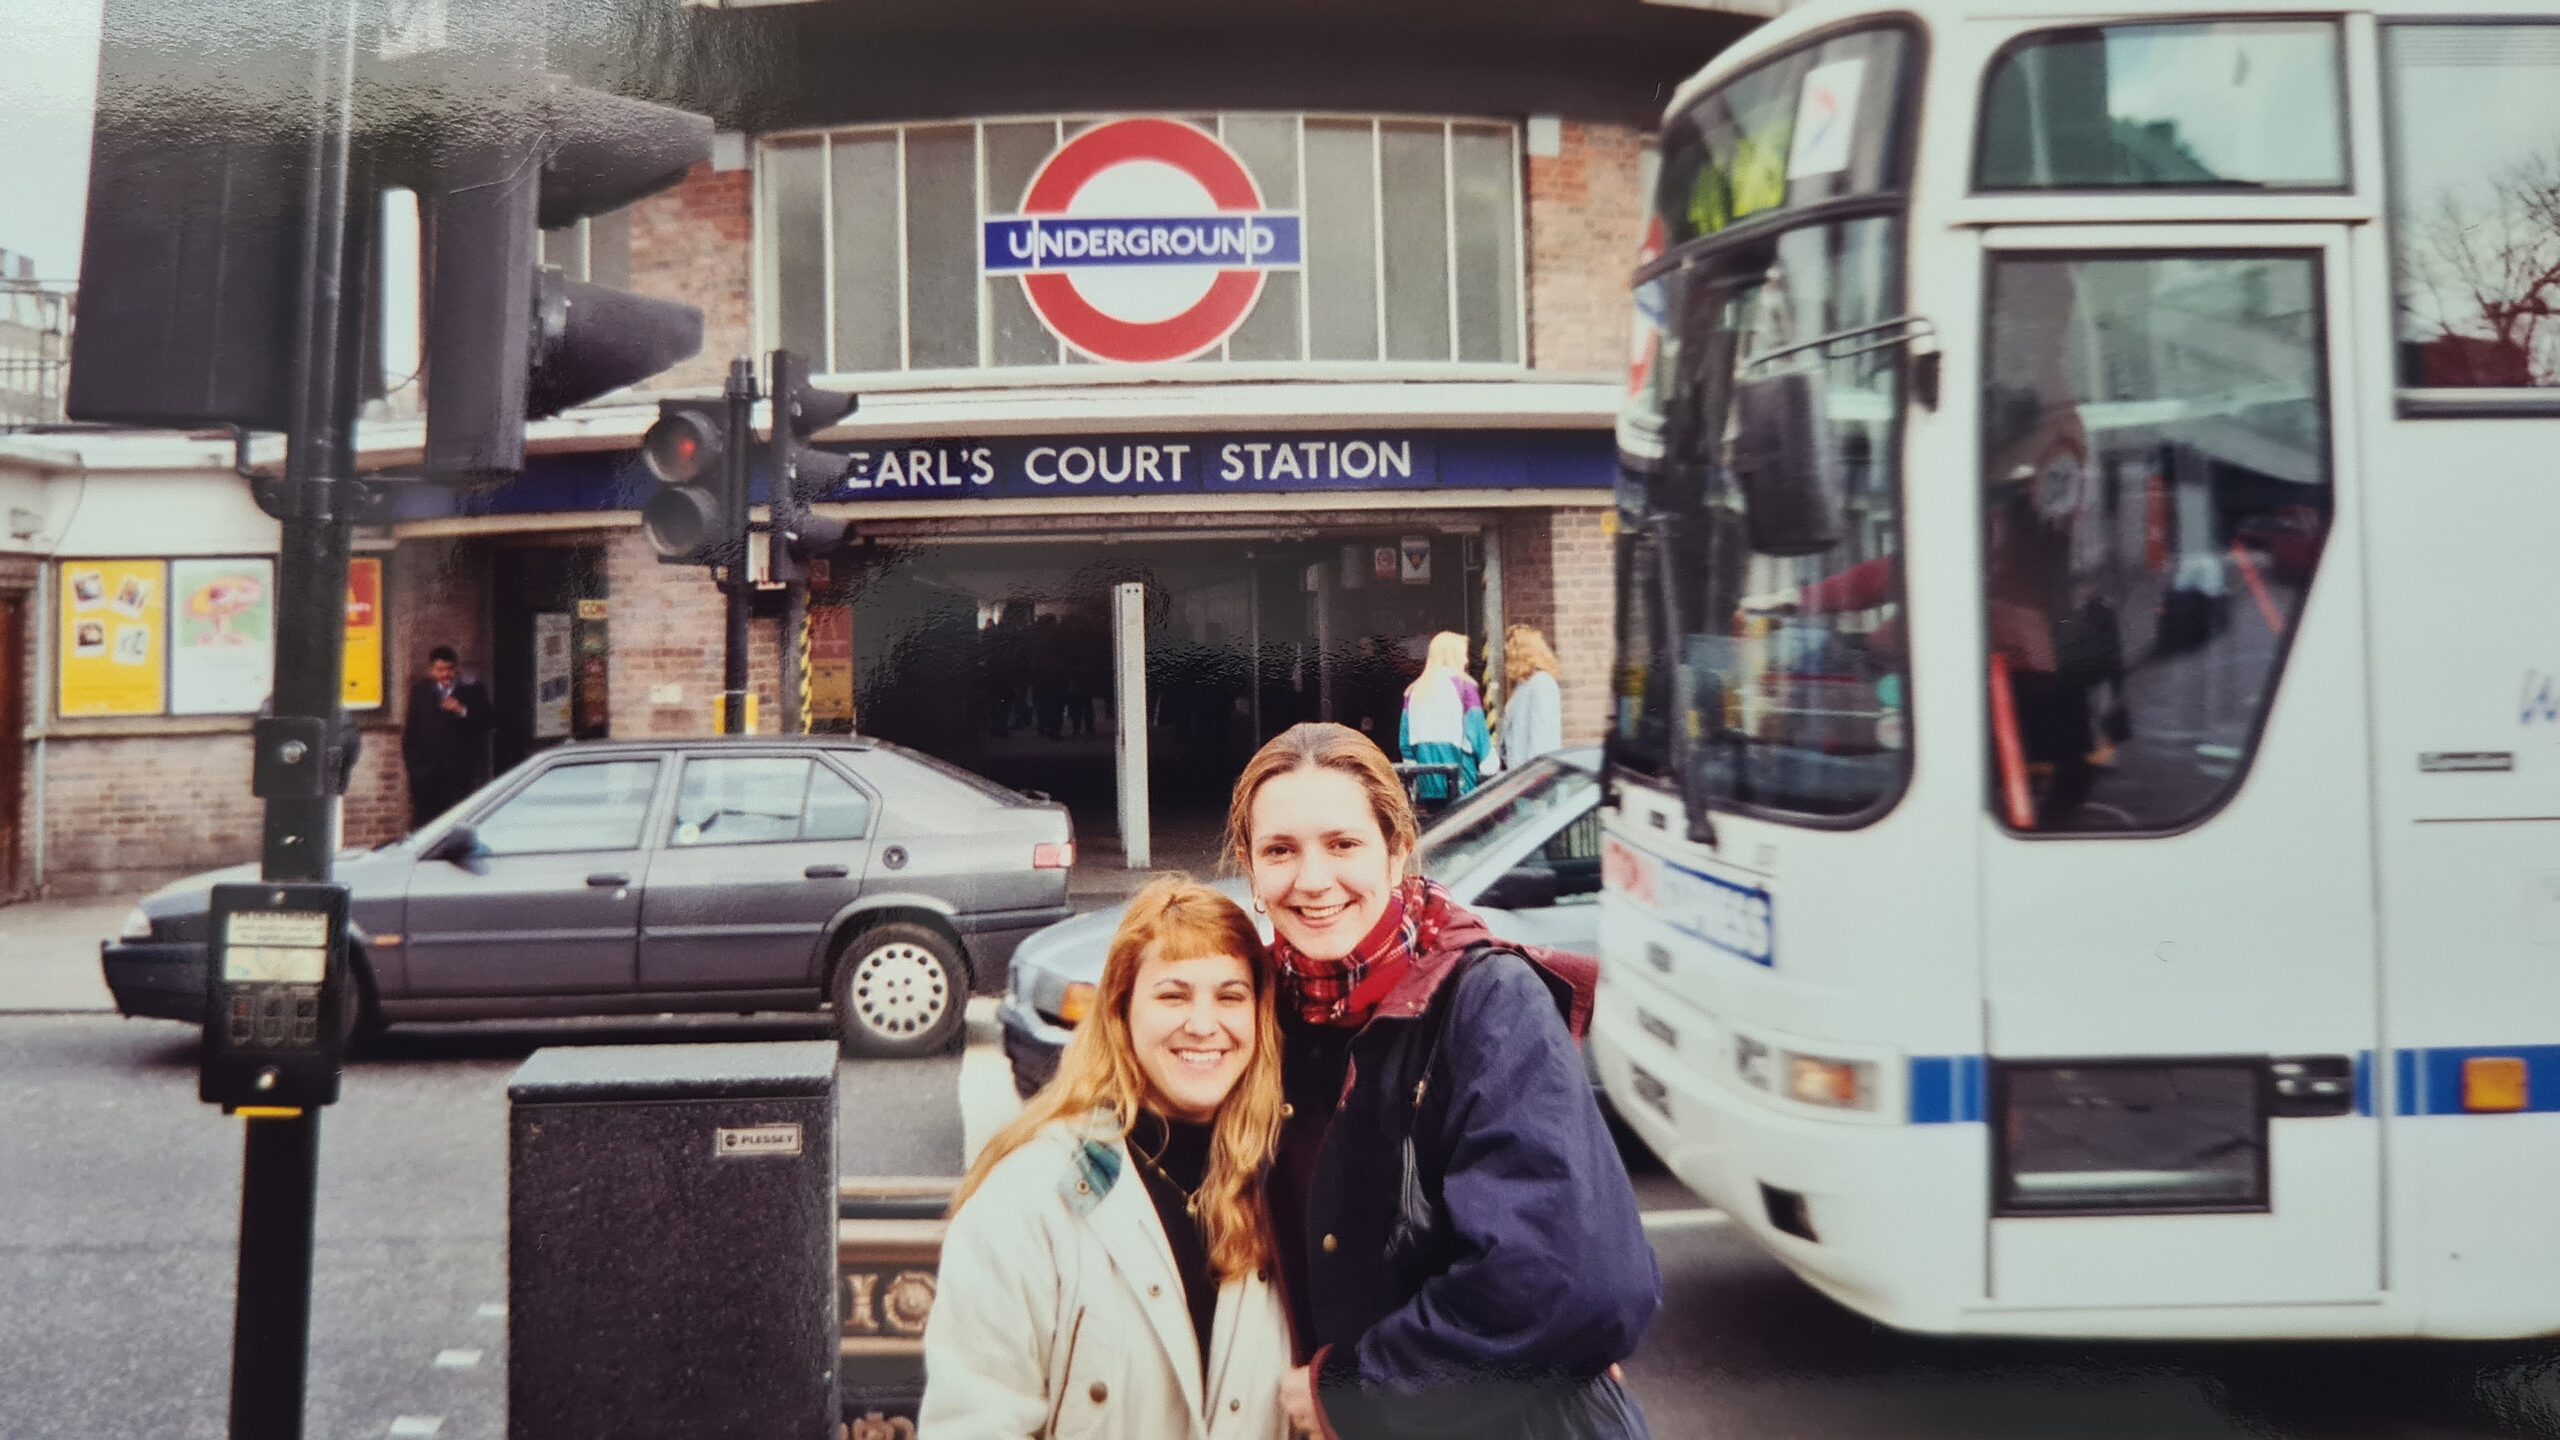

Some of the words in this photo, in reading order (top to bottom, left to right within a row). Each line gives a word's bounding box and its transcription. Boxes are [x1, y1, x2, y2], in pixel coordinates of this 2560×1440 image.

[1009, 225, 1275, 259] UNDERGROUND
[848, 448, 995, 488] EARL'S
[1024, 445, 1191, 485] COURT
[1220, 440, 1412, 482] STATION
